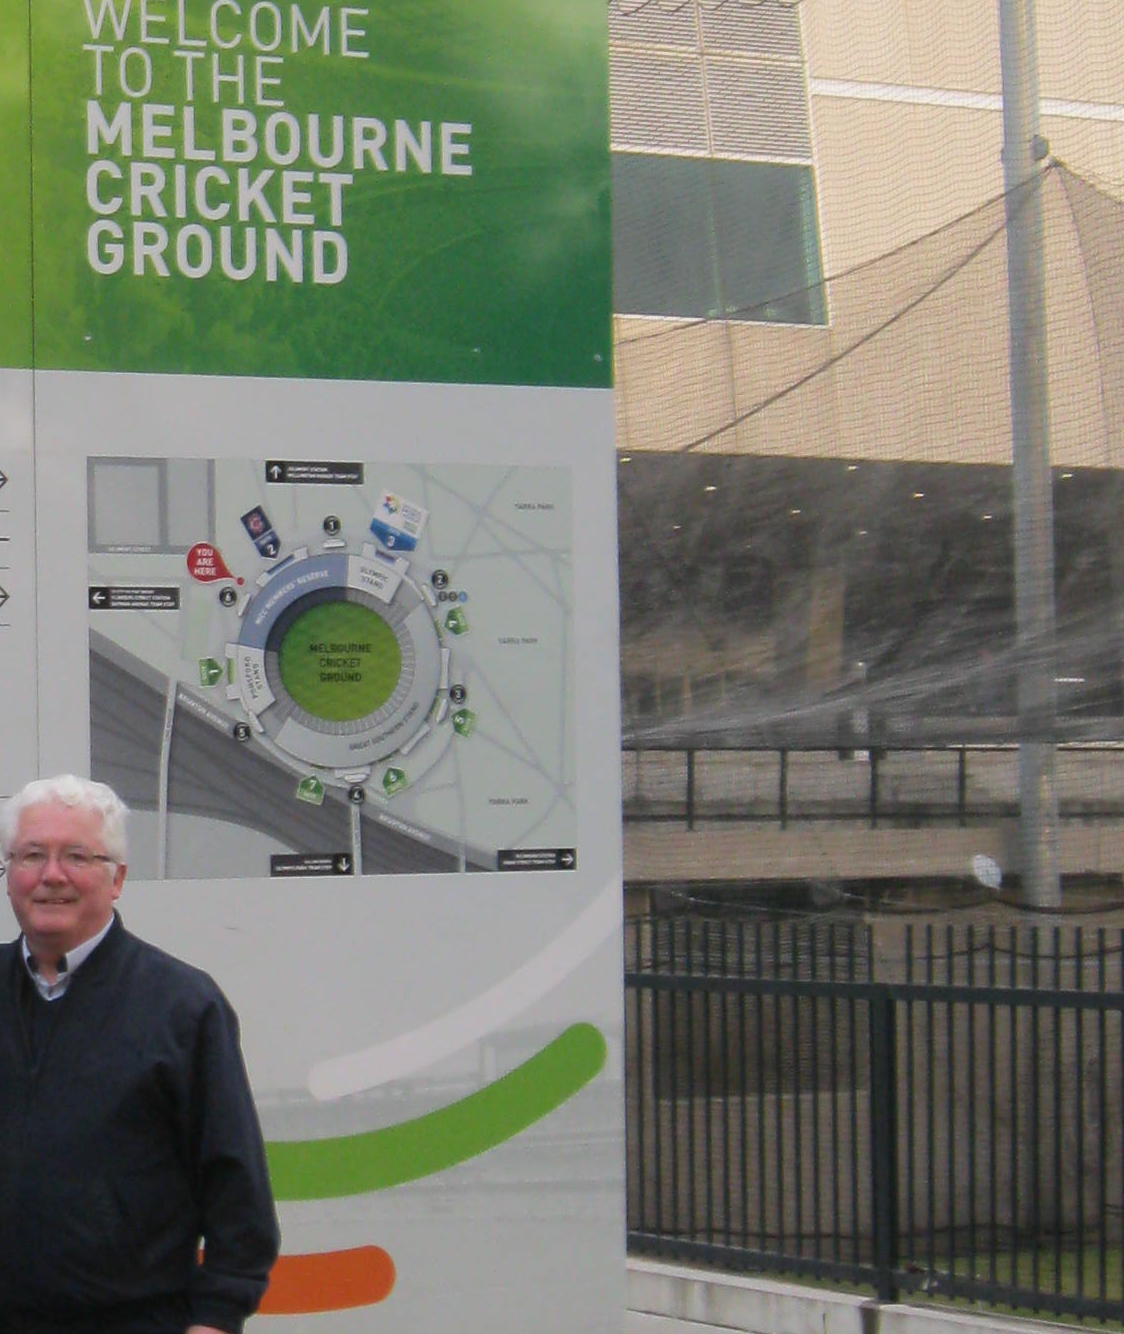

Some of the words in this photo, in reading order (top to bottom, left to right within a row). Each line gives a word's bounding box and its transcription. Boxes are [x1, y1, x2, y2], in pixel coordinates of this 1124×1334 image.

[82, 43, 153, 97] TO
[174, 50, 285, 107] THE
[86, 99, 473, 176] MELBOURNE
[86, 159, 354, 227] CRICKET
[86, 219, 349, 285] GROUND
[196, 548, 214, 556] YOU
[196, 557, 215, 566] ARE
[194, 567, 217, 576] HERE
[309, 643, 373, 653] MELBOURNE
[319, 658, 362, 668] CRICKET
[319, 672, 363, 682] GROUND
